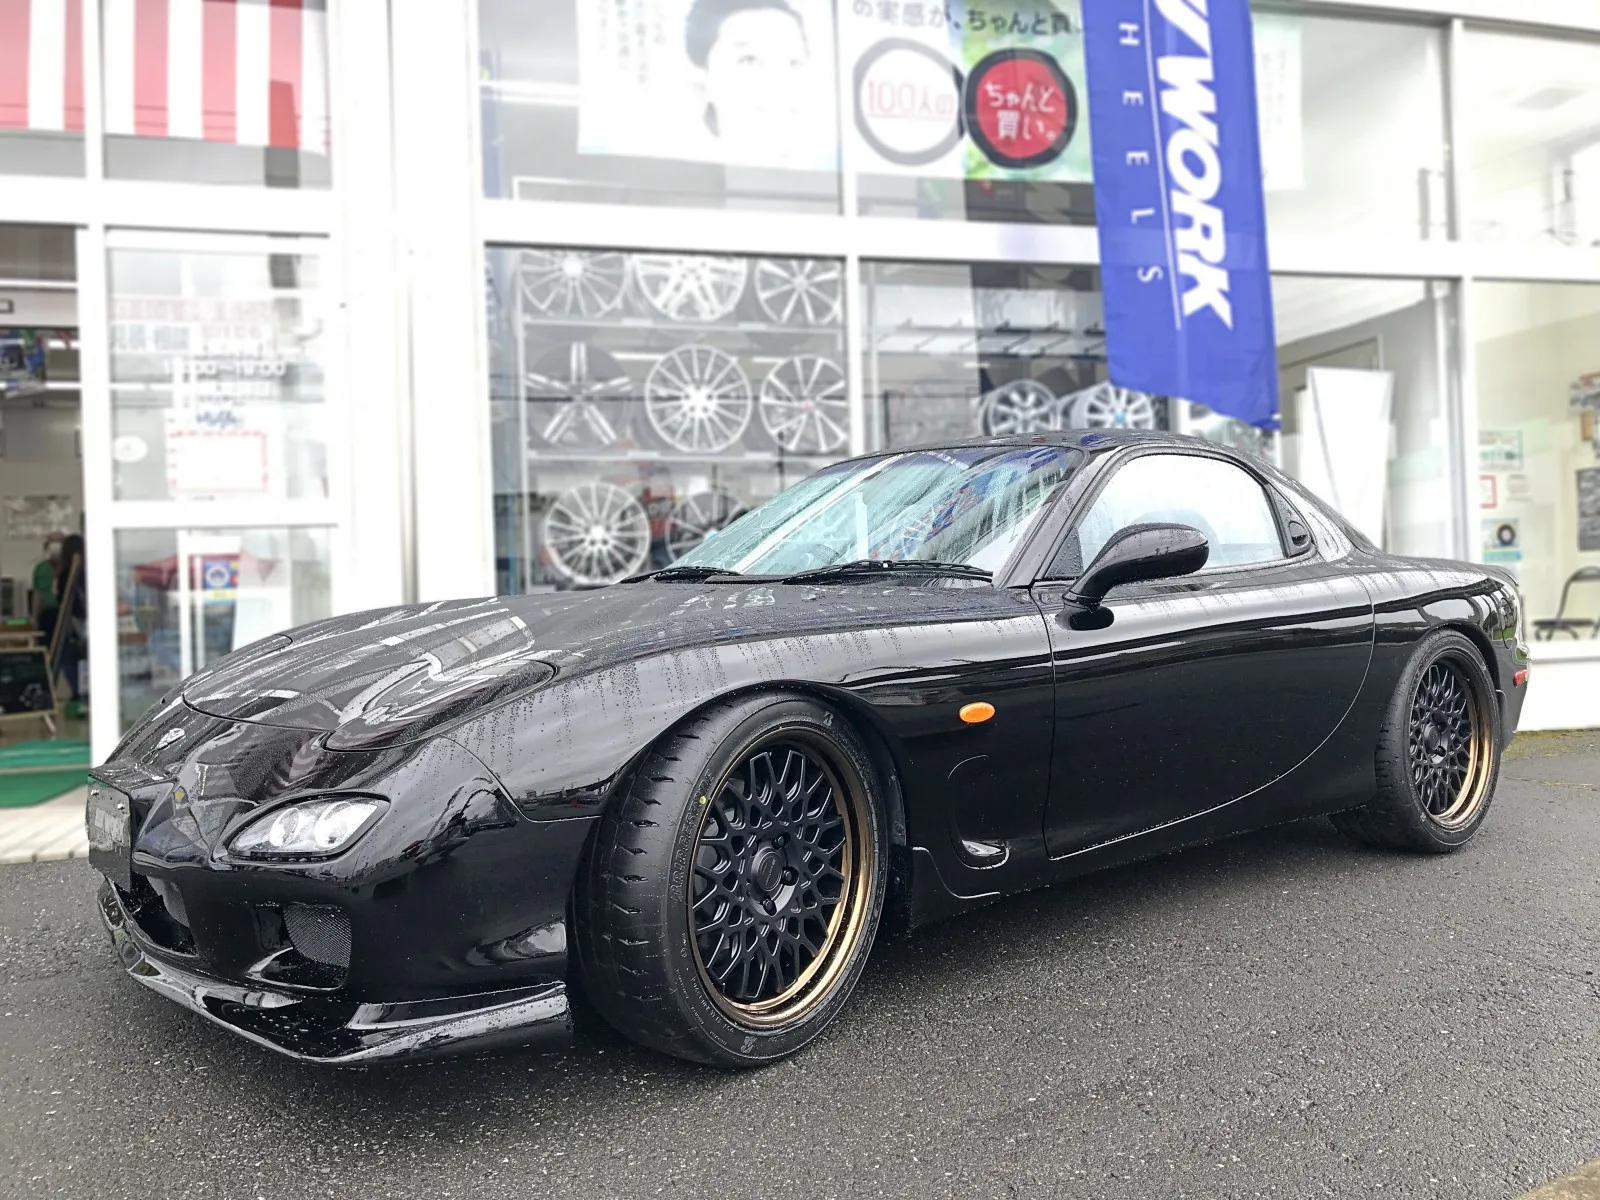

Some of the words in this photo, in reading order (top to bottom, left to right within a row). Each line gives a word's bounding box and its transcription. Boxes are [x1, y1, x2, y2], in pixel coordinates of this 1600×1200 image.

[983, 80, 1056, 113] ちゃんと
[1156, 56, 1233, 330] WORK
